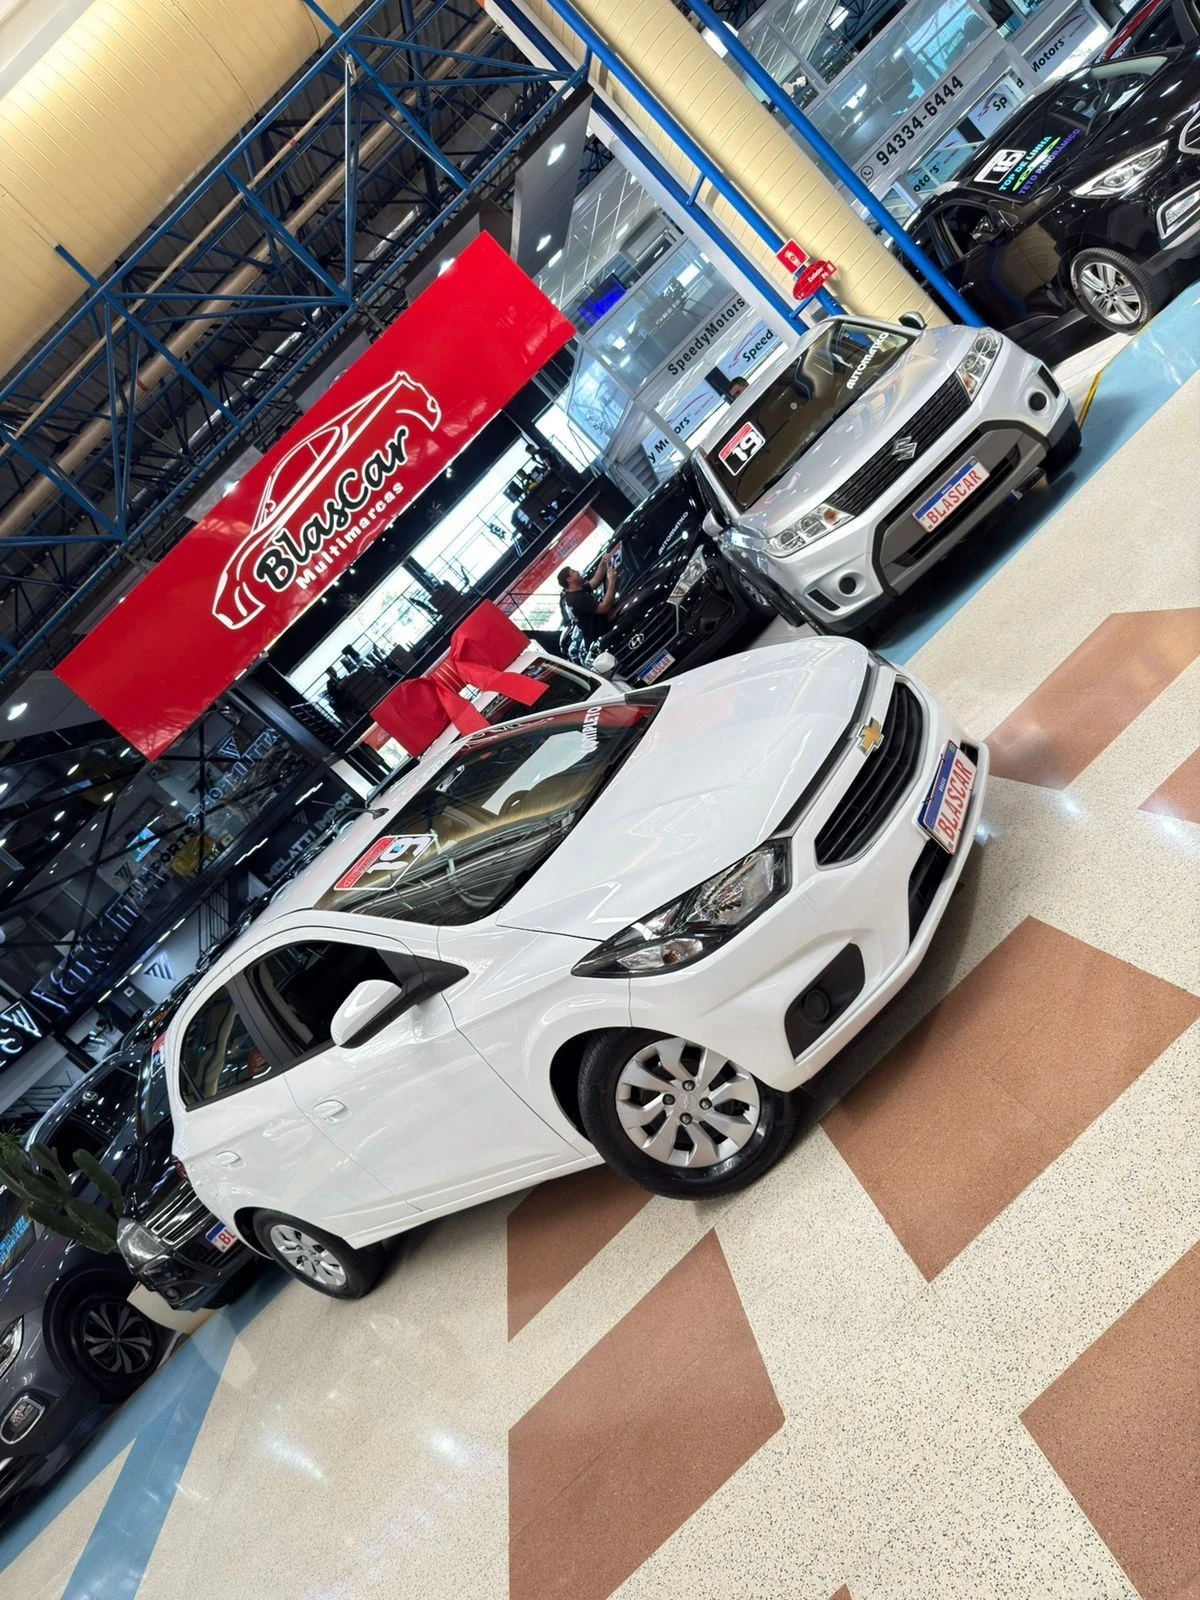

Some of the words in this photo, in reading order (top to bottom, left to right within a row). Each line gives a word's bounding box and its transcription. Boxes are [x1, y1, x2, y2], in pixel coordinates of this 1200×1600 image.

[876, 75, 964, 166] 94334-6444
[913, 163, 940, 192] otors
[998, 173, 1015, 192] TOP
[1014, 161, 1028, 173] DE
[1026, 136, 1053, 161] LINHA
[1018, 174, 1038, 195] TETO
[667, 298, 746, 376] SpeedyMotors
[742, 328, 775, 363] Speed
[731, 429, 760, 461] 19
[255, 427, 408, 590] BlasCar
[926, 470, 982, 524] BLASCAR
[296, 481, 404, 590] Multimarcas
[645, 656, 671, 682] BLASCAR
[314, 792, 354, 831] IMPOR
[937, 758, 973, 841] BLASCAR
[366, 836, 432, 875] 19
